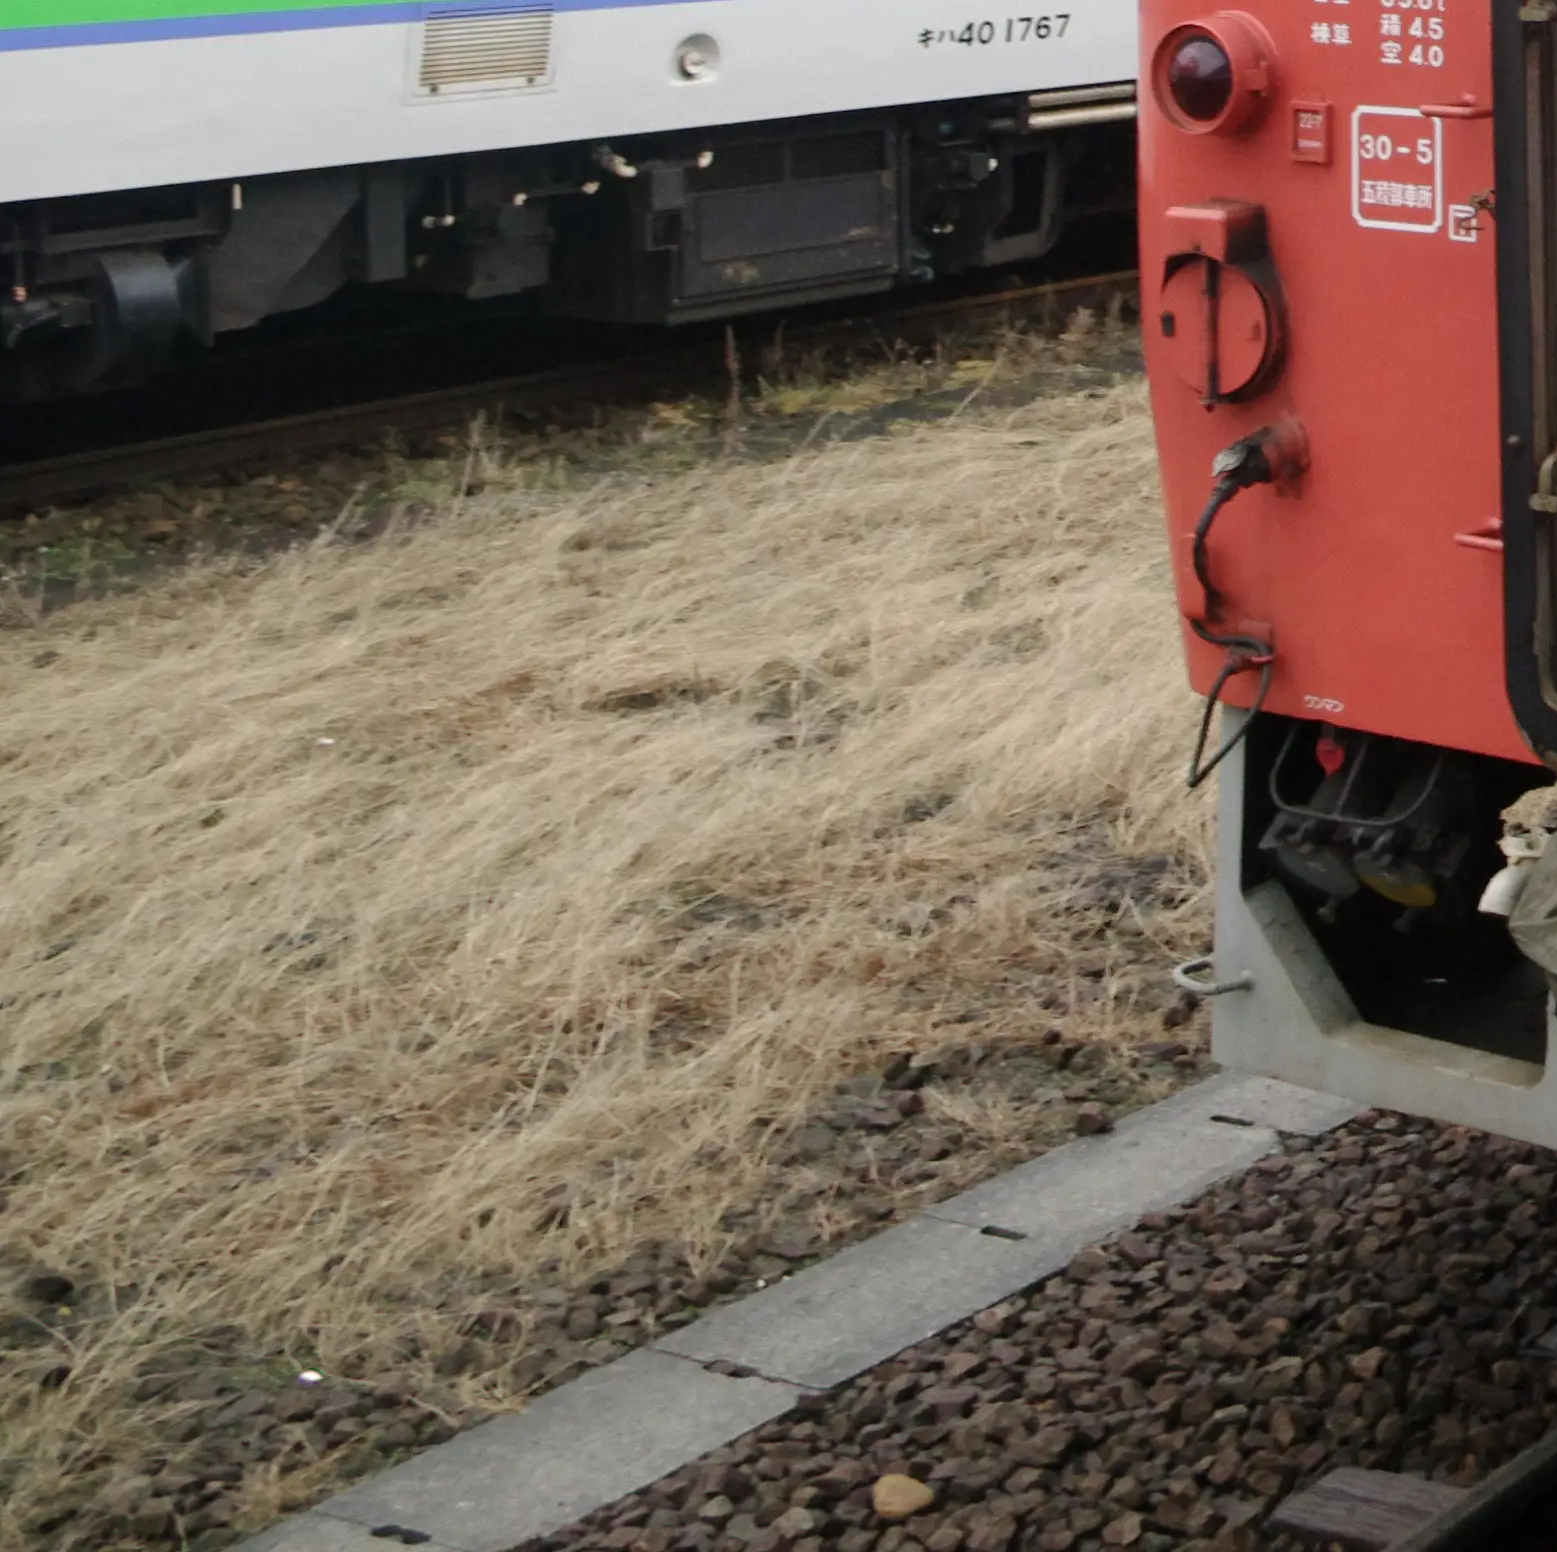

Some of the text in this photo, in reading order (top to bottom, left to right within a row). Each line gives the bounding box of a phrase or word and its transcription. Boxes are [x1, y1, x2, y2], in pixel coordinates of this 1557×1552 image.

[917, 12, 1071, 49] キハ40 1767
[1408, 16, 1445, 40] 4.5
[1408, 43, 1445, 68] 4.0
